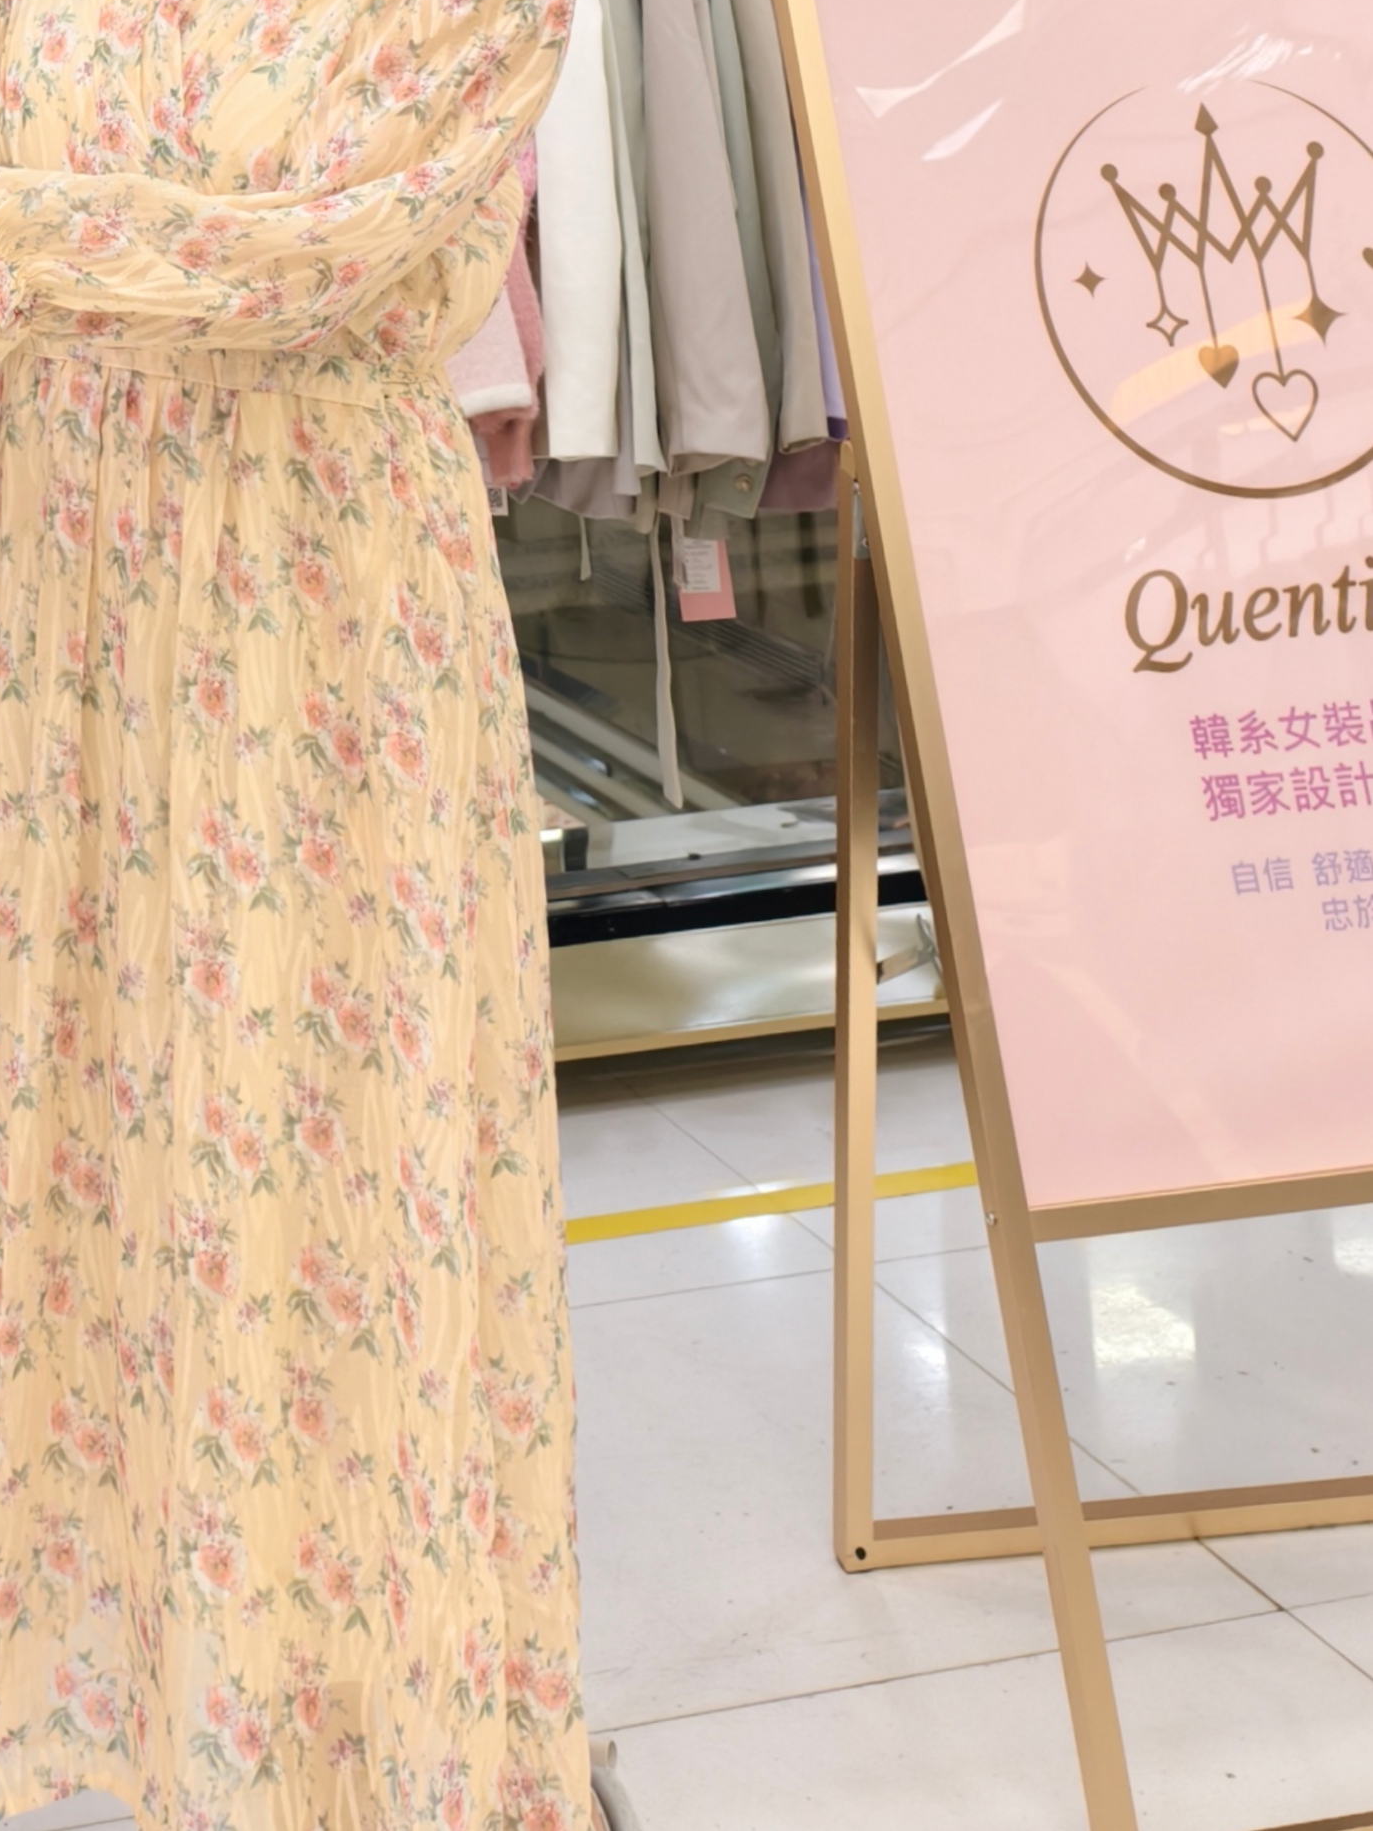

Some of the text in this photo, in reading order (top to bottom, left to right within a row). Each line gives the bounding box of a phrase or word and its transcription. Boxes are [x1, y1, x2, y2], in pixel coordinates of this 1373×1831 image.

[1189, 699, 1373, 760] 韓系女裝
[1201, 760, 1373, 821] 獨家設計
[1231, 848, 1373, 895] 自信 舒適
